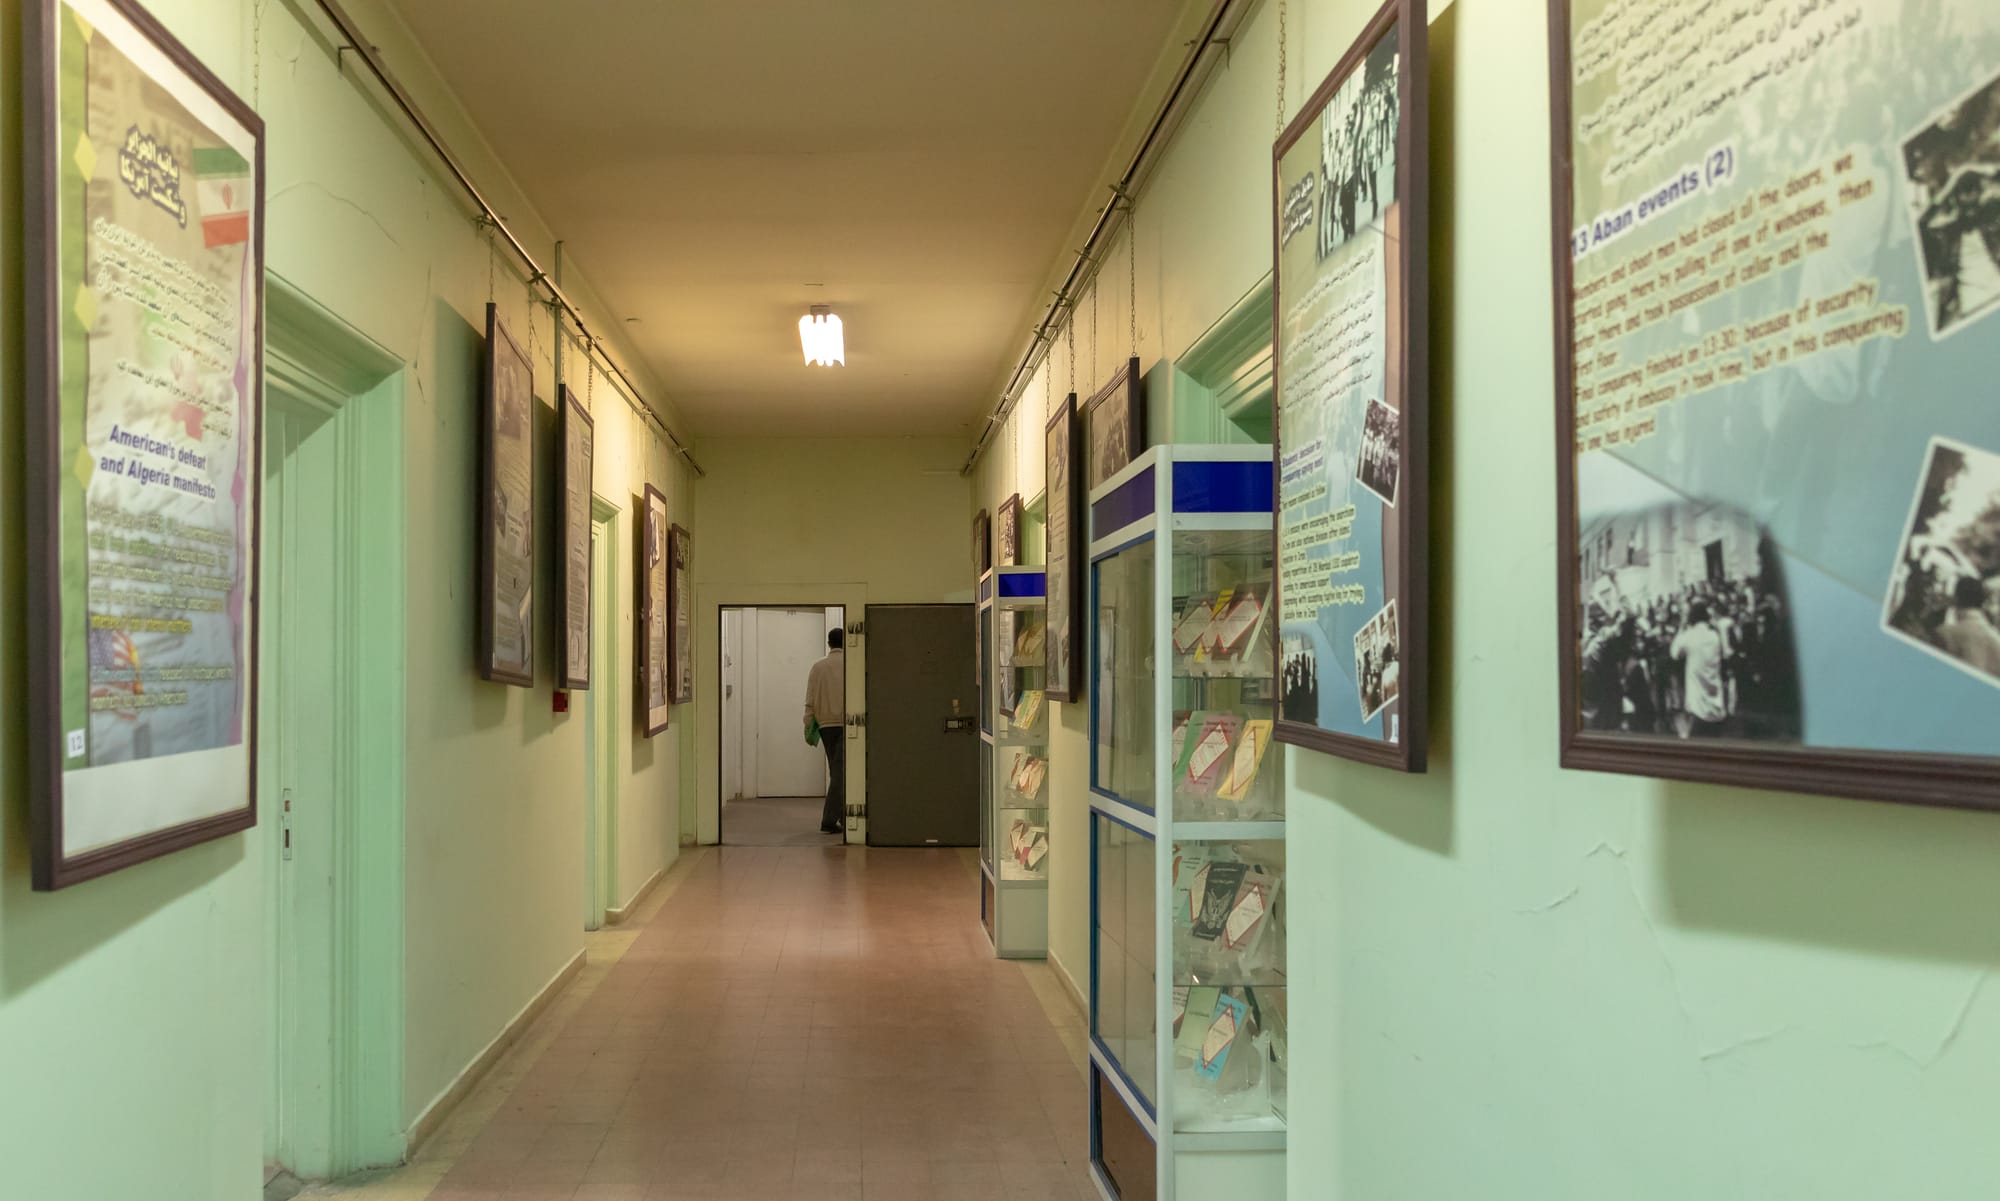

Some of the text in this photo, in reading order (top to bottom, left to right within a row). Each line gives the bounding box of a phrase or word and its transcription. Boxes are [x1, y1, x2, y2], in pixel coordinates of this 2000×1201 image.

[1593, 208, 1633, 246] Aban
[1638, 170, 1699, 219] events
[1705, 145, 1734, 188] (2)
[1701, 208, 1736, 239] closed
[1815, 282, 1874, 318] security
[1822, 308, 1905, 348] conquering
[109, 424, 176, 461] American's
[178, 446, 207, 471] defeat
[100, 455, 217, 501] and Algeria manifesto
